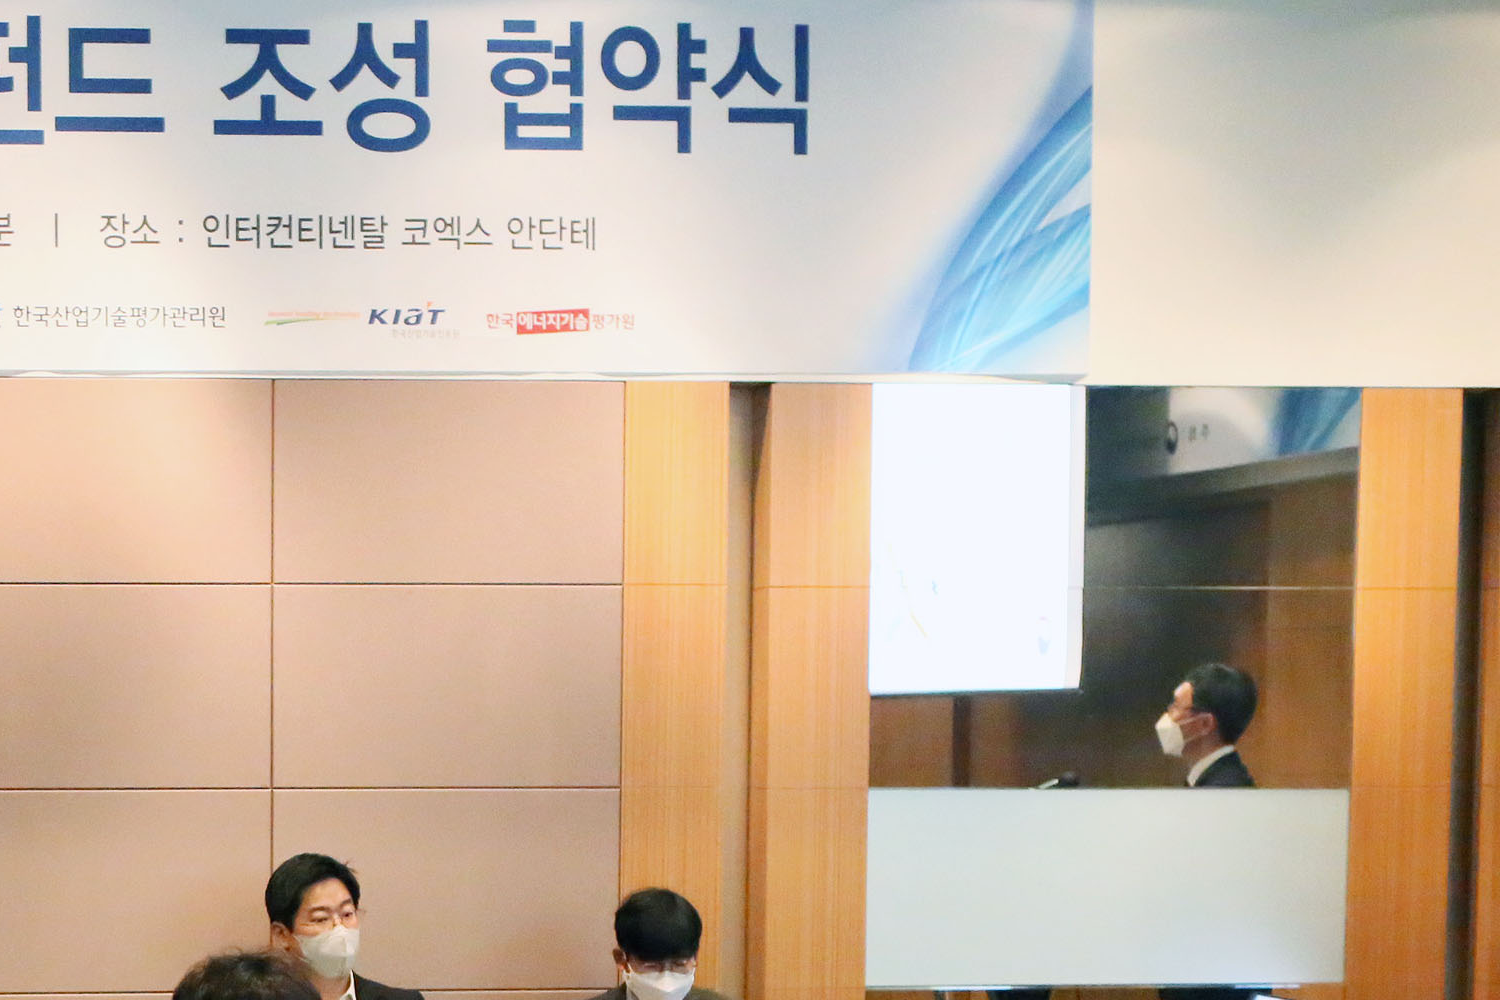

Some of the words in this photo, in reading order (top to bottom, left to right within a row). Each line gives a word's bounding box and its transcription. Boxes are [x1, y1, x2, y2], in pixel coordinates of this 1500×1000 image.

[213, 19, 431, 153] 조성
[486, 19, 811, 156] 협약식
[99, 213, 161, 249] 장소
[202, 213, 389, 250] 인터컨티넨탈
[401, 215, 493, 251] 코엑스
[507, 216, 596, 251] 안단테
[12, 305, 226, 329] 한국산업기술평가관리원
